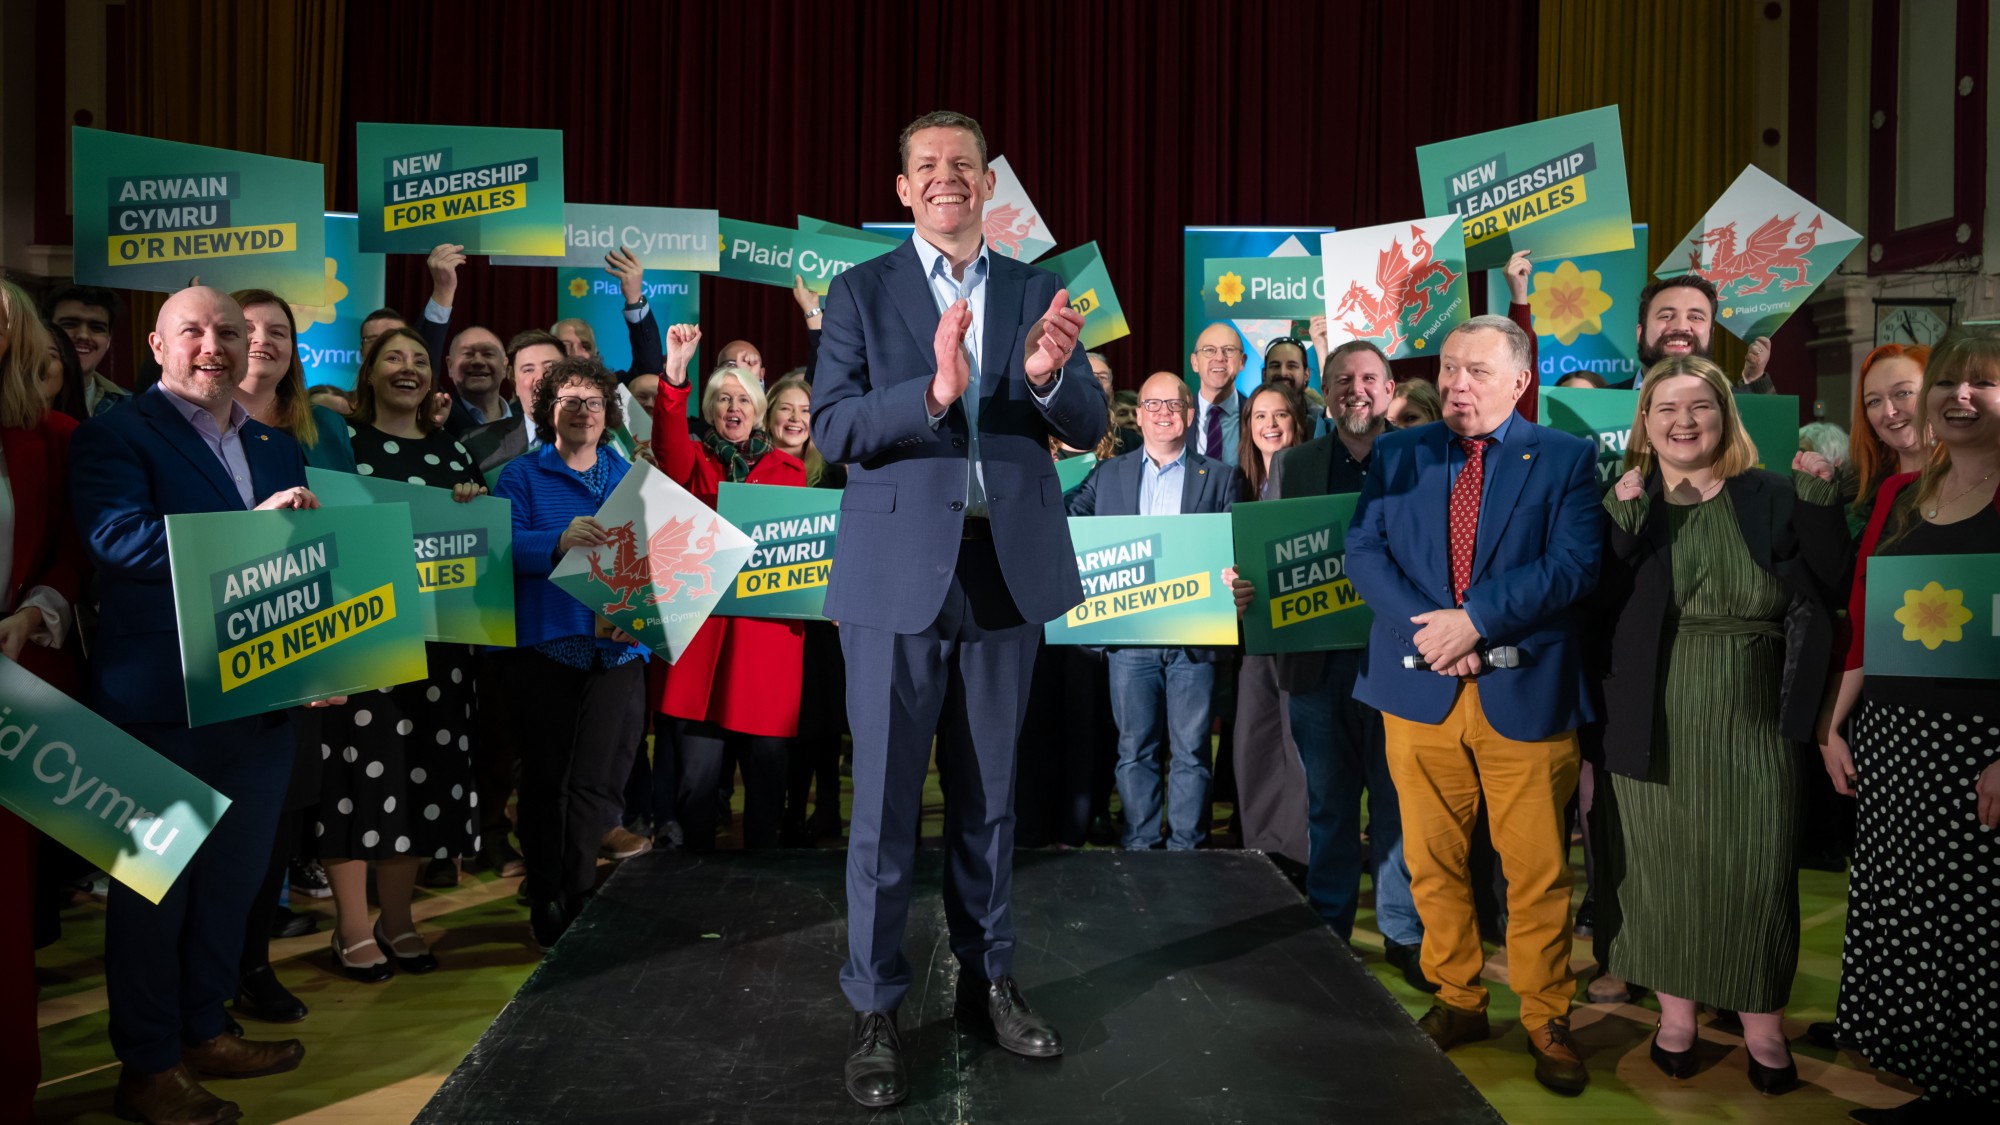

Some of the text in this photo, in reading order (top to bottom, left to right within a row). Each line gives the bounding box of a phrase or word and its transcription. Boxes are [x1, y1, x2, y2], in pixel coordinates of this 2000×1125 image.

[392, 152, 443, 178] NEW
[1452, 160, 1497, 196] NEW
[118, 176, 228, 202] ARWAIN
[392, 163, 528, 202] LEADERSHIP
[1455, 152, 1585, 220] LEADERSHIP
[119, 205, 217, 231] CYMRU
[393, 189, 516, 226] FOR WALES
[1502, 184, 1575, 227] WALES
[120, 228, 284, 261] O'R NEWYDD
[563, 223, 707, 255] laid Cymru
[731, 238, 856, 279] Plaid Cym
[1251, 276, 1307, 300] Plaid
[1422, 297, 1463, 340] Plaid Cymru
[1735, 301, 1791, 315] Plaid Cymru
[750, 513, 837, 542] ARWAIN
[413, 533, 478, 559] RSHIP
[747, 540, 826, 569] CYMRU
[1275, 528, 1330, 565] NEW
[223, 541, 327, 605] ARWAIN
[417, 563, 466, 588] LES
[746, 564, 831, 593] O'R NEW
[226, 581, 321, 641] CYMRU
[1075, 579, 1200, 621] O'R NEWYDD
[1280, 590, 1330, 622] FOR
[646, 610, 701, 627] Plaid Cymru
[231, 595, 385, 680] O'R NEWYDD
[32, 740, 180, 856] Cymru
